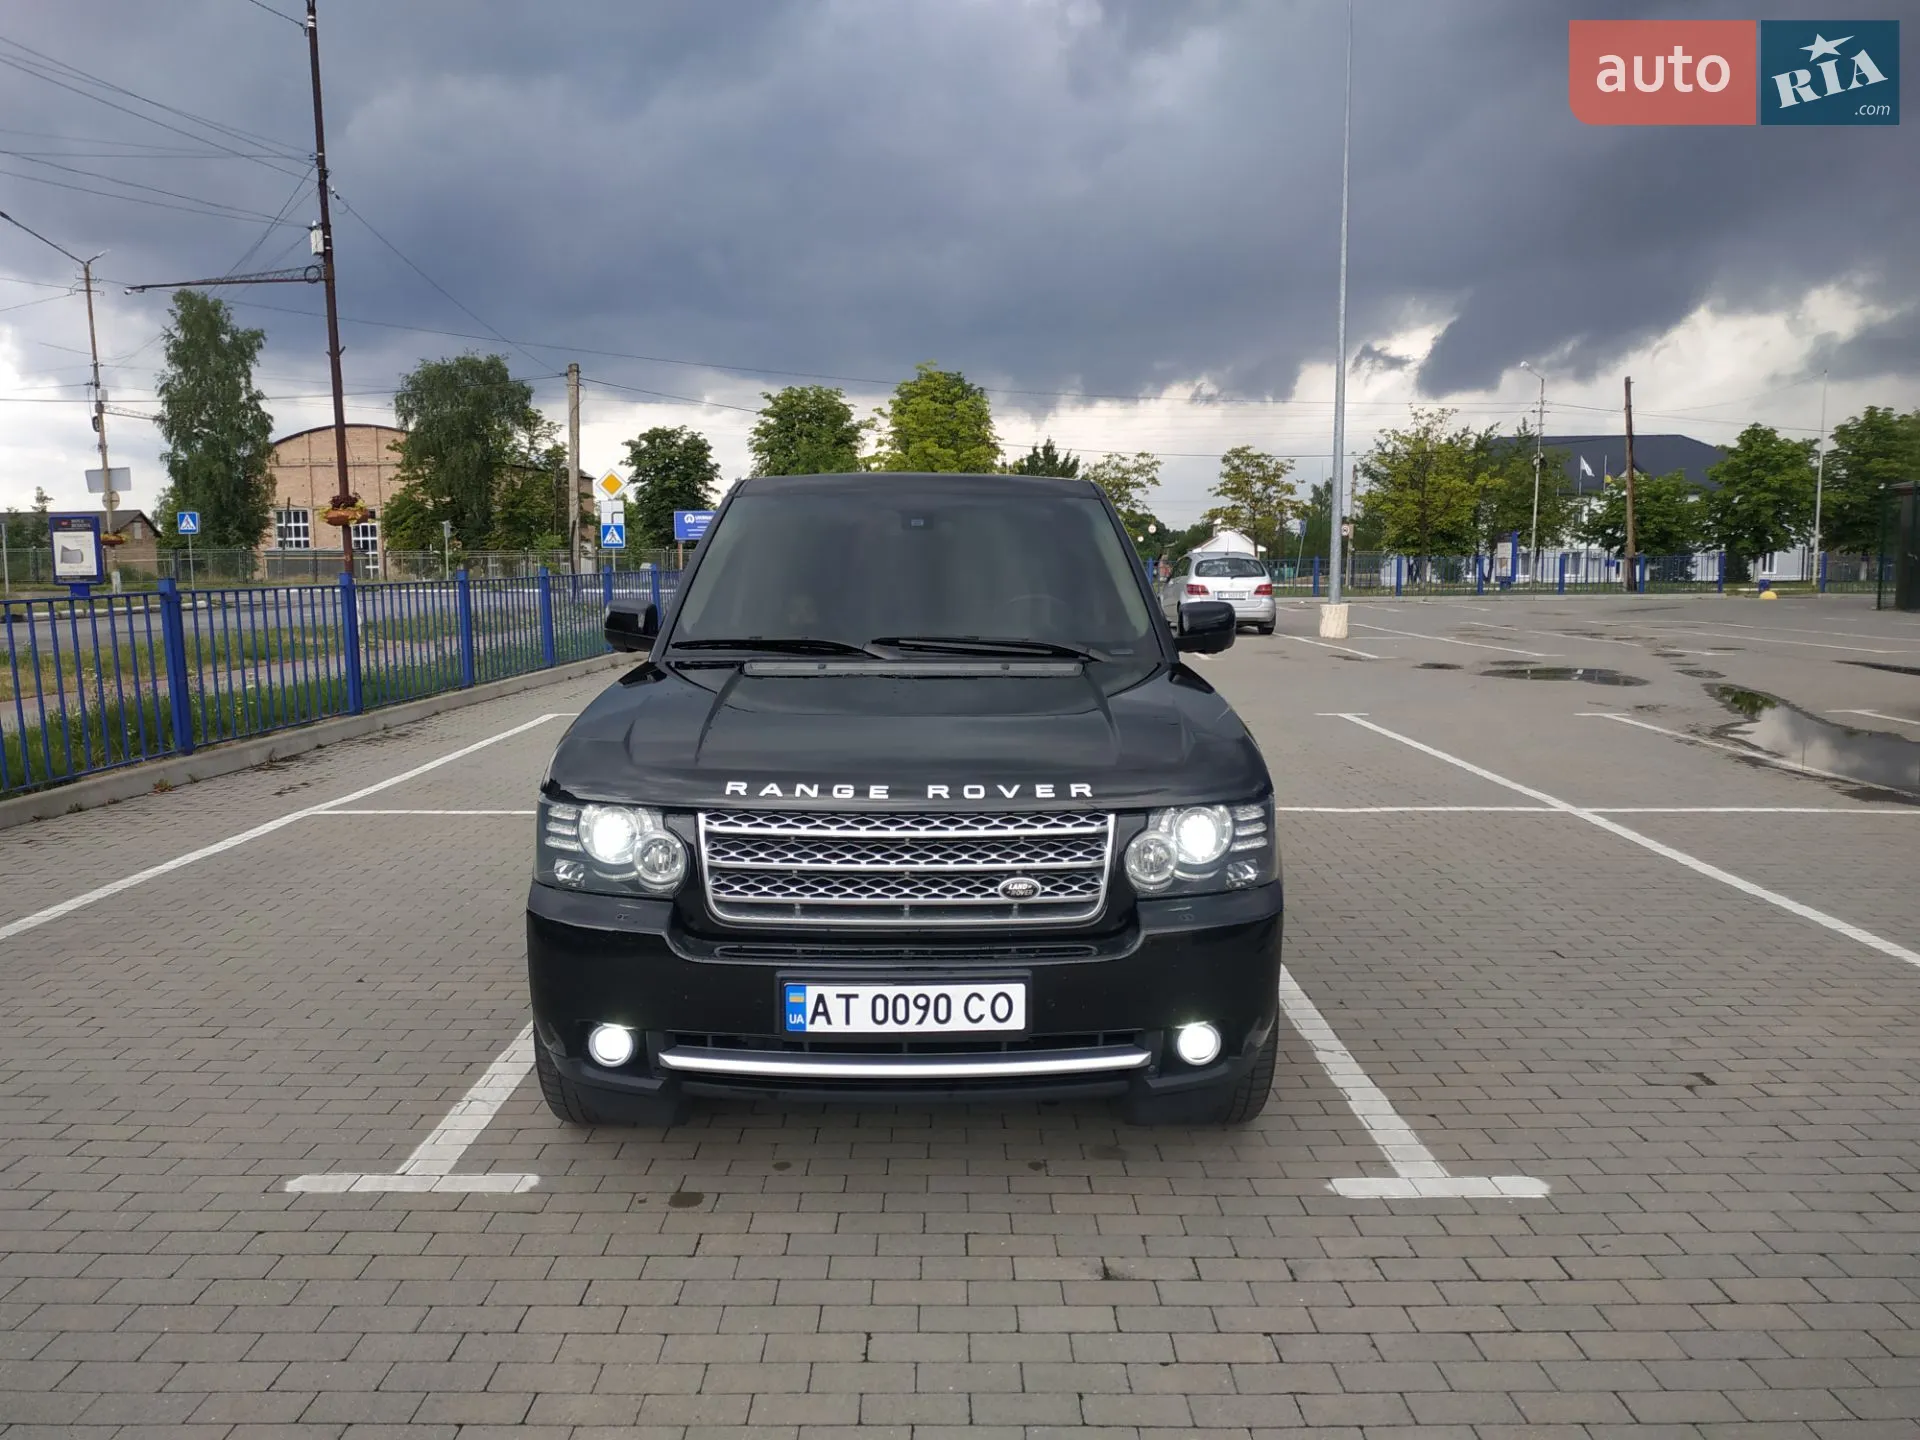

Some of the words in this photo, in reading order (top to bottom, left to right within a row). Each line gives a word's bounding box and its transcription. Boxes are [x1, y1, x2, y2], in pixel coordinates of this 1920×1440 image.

[725, 781, 890, 799] RANGE
[927, 783, 1094, 799] ROVER
[809, 992, 859, 1025] AT
[871, 992, 952, 1025] 0090
[964, 992, 1014, 1023] CO
[789, 1014, 804, 1024] UA
